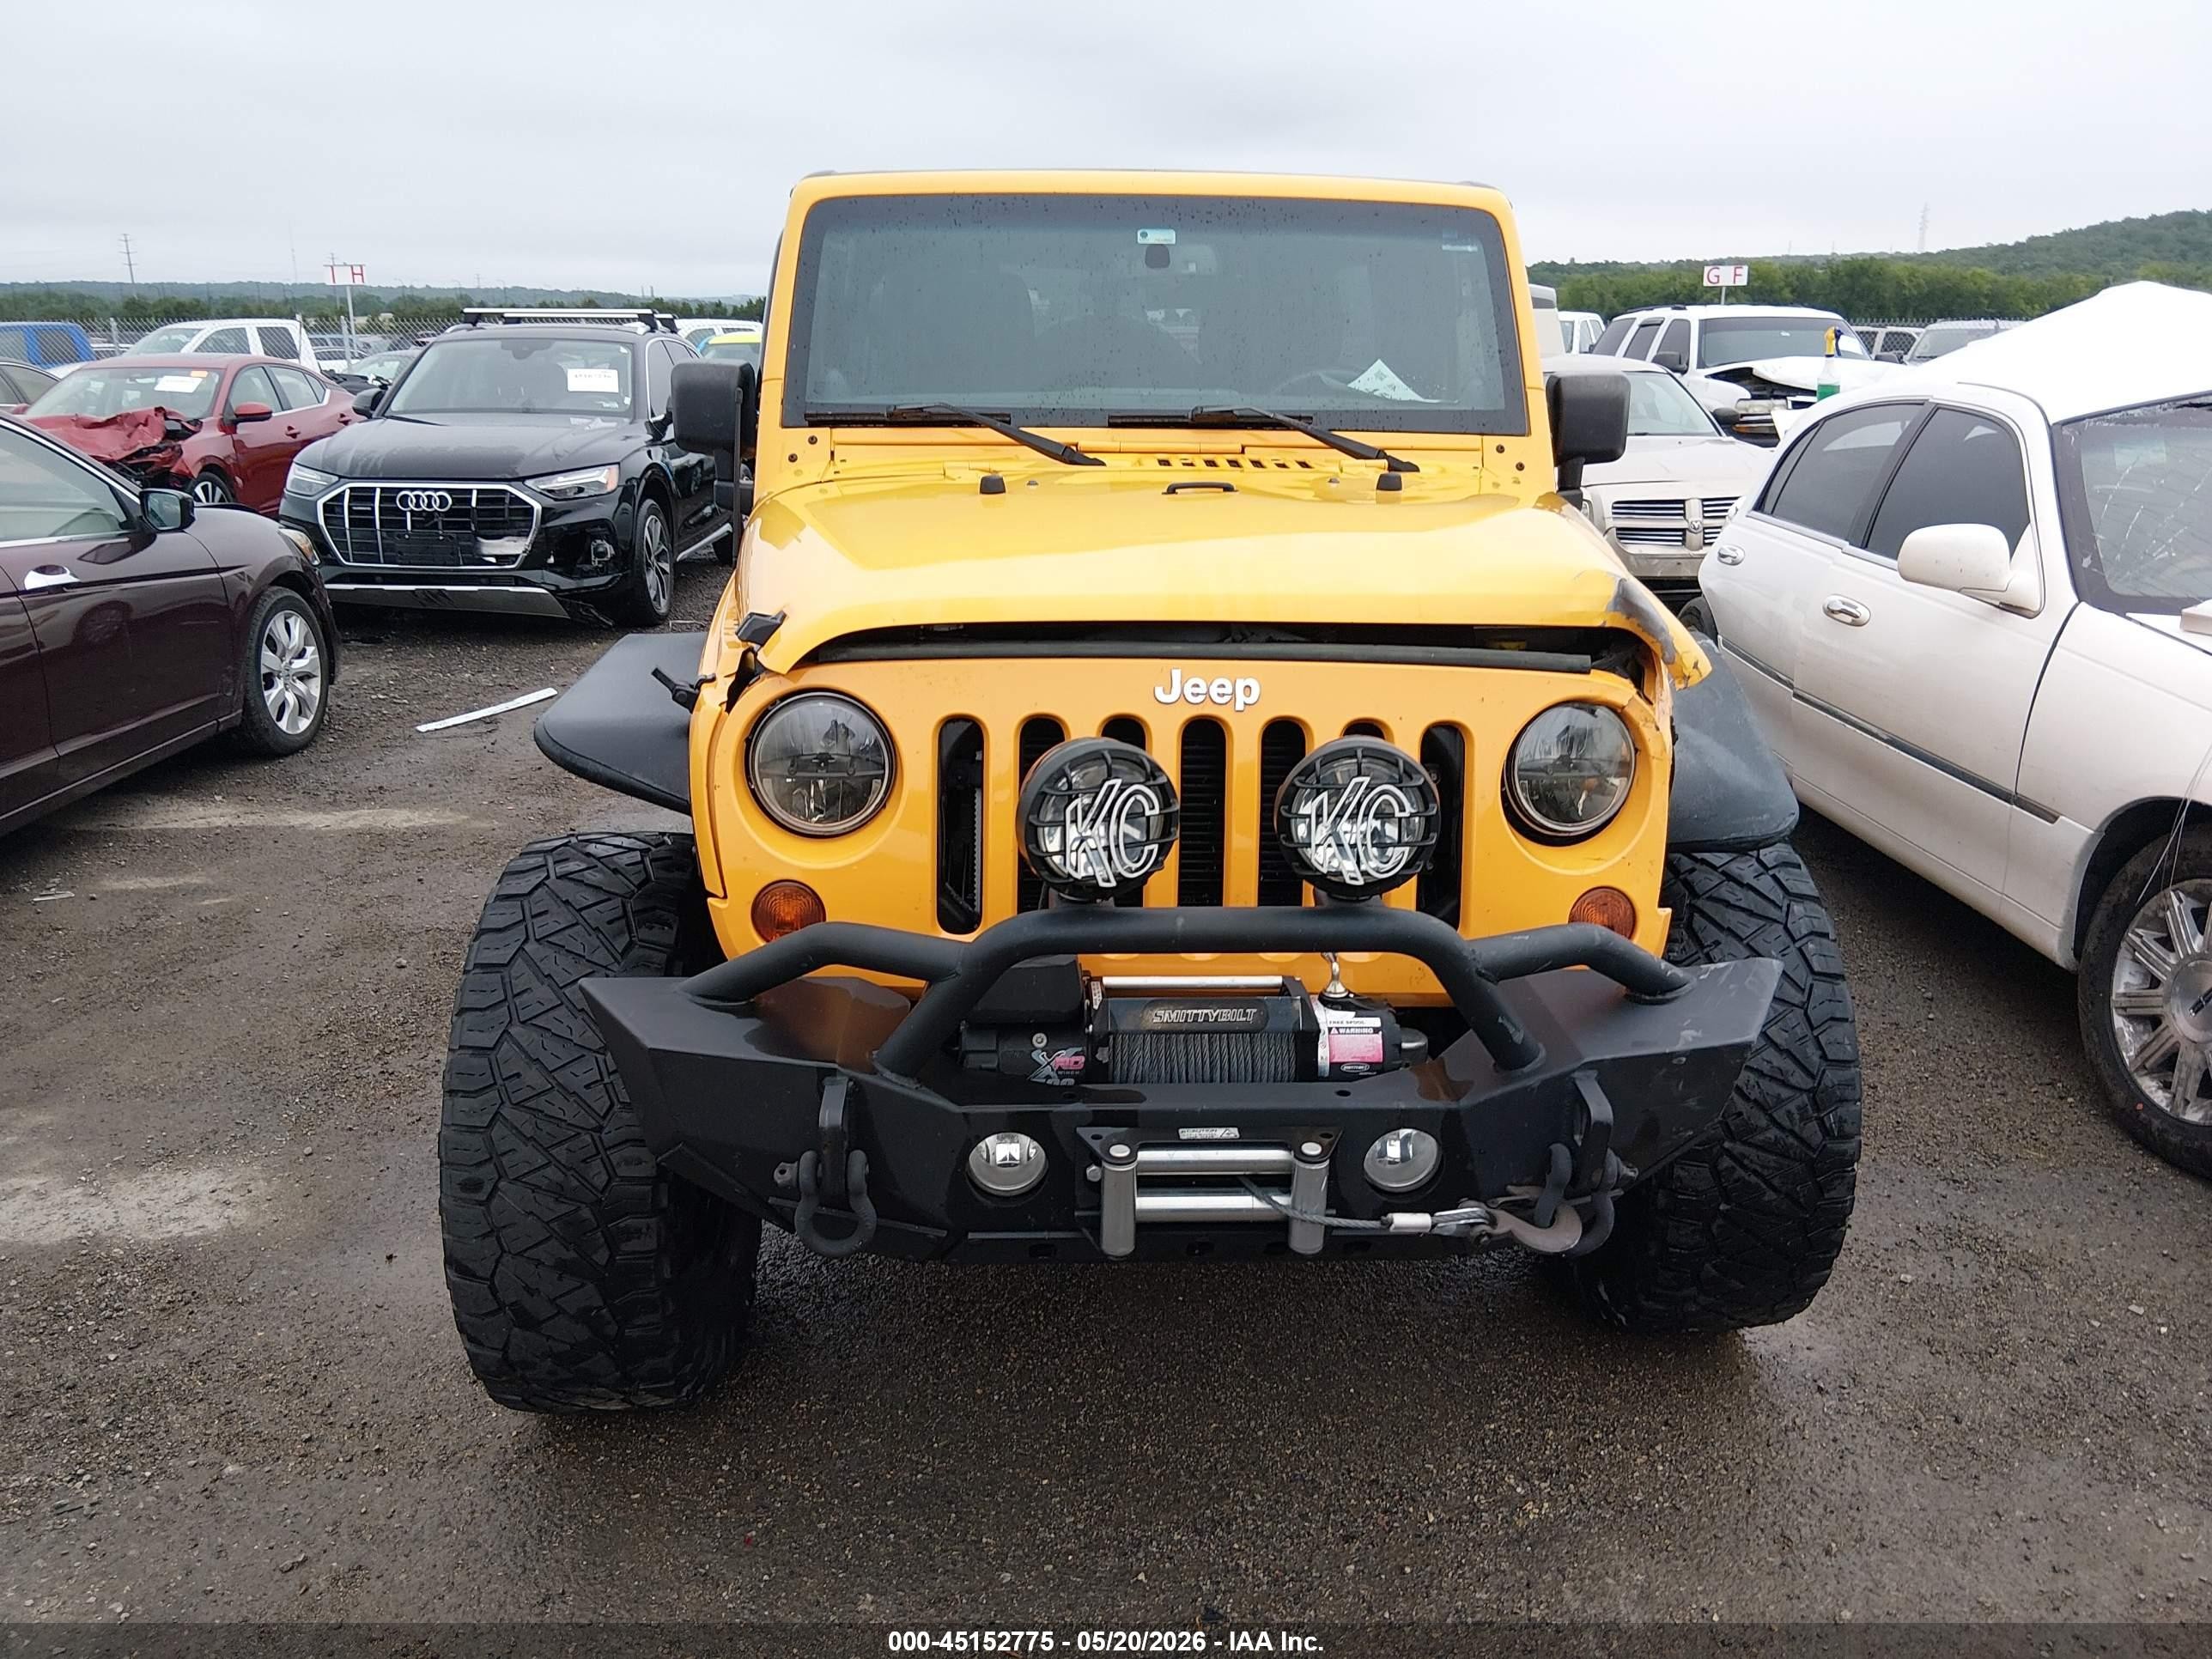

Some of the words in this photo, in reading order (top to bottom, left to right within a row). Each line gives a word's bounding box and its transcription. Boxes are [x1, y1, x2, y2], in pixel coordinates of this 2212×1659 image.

[350, 264, 365, 283] H
[1707, 266, 1720, 284] G
[1733, 266, 1743, 284] F
[1153, 667, 1261, 712] Jeep
[1065, 778, 1161, 888] KC
[1310, 775, 1412, 886] KC
[1152, 1008, 1258, 1024] SMITTYBILT
